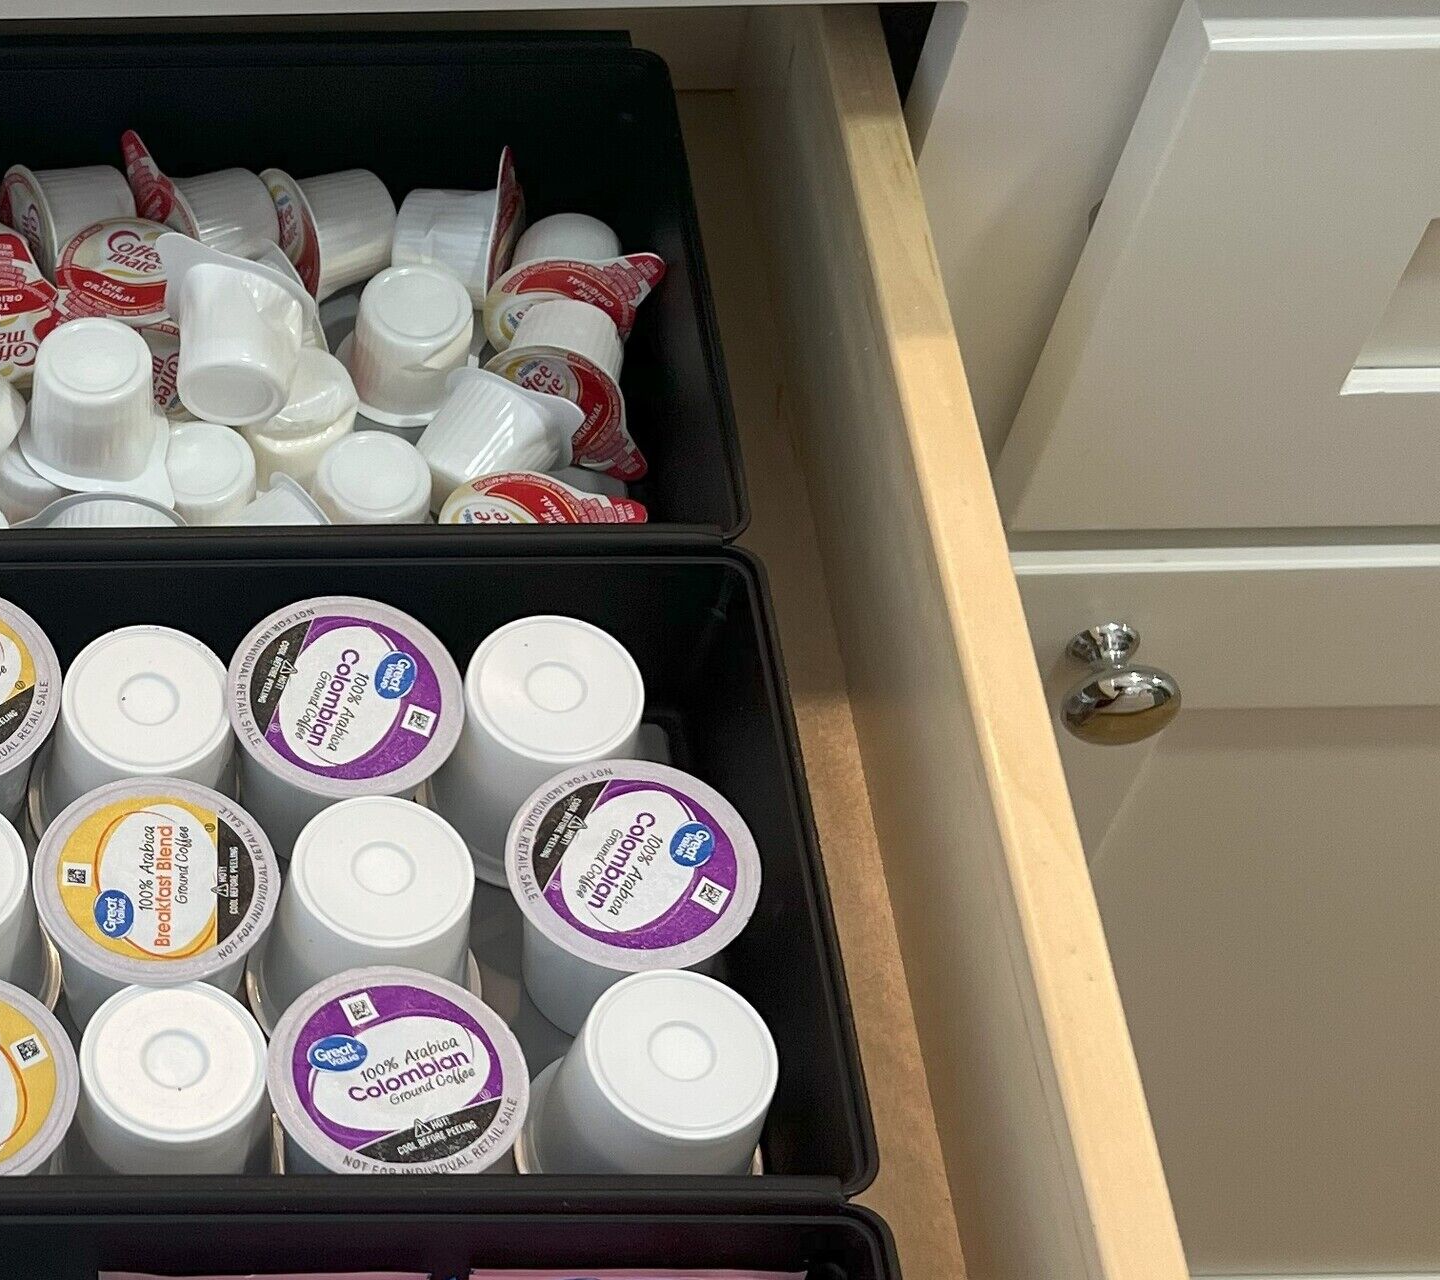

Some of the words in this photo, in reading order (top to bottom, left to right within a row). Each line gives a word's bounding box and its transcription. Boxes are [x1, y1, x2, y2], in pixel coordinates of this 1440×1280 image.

[107, 252, 157, 273] mate
[83, 281, 136, 304] ORIGINAL
[101, 280, 125, 293] THE
[307, 649, 360, 747] Colombian
[348, 672, 370, 706] 100%
[326, 706, 356, 752] Arabica
[139, 826, 155, 874] Arabica
[156, 826, 173, 871] Blend
[587, 812, 656, 910] Colombian
[637, 834, 664, 867] 100%
[138, 879, 154, 911] 100%
[154, 875, 172, 947] Breakfast
[608, 867, 644, 916] Arabica
[313, 1043, 354, 1062] Great
[328, 1053, 360, 1066] Value
[360, 1058, 399, 1082] 100%
[404, 1037, 460, 1066] Arabica
[348, 1052, 470, 1102] Colombian
[389, 1080, 434, 1106] Ground
[435, 1066, 476, 1091] Coffee
